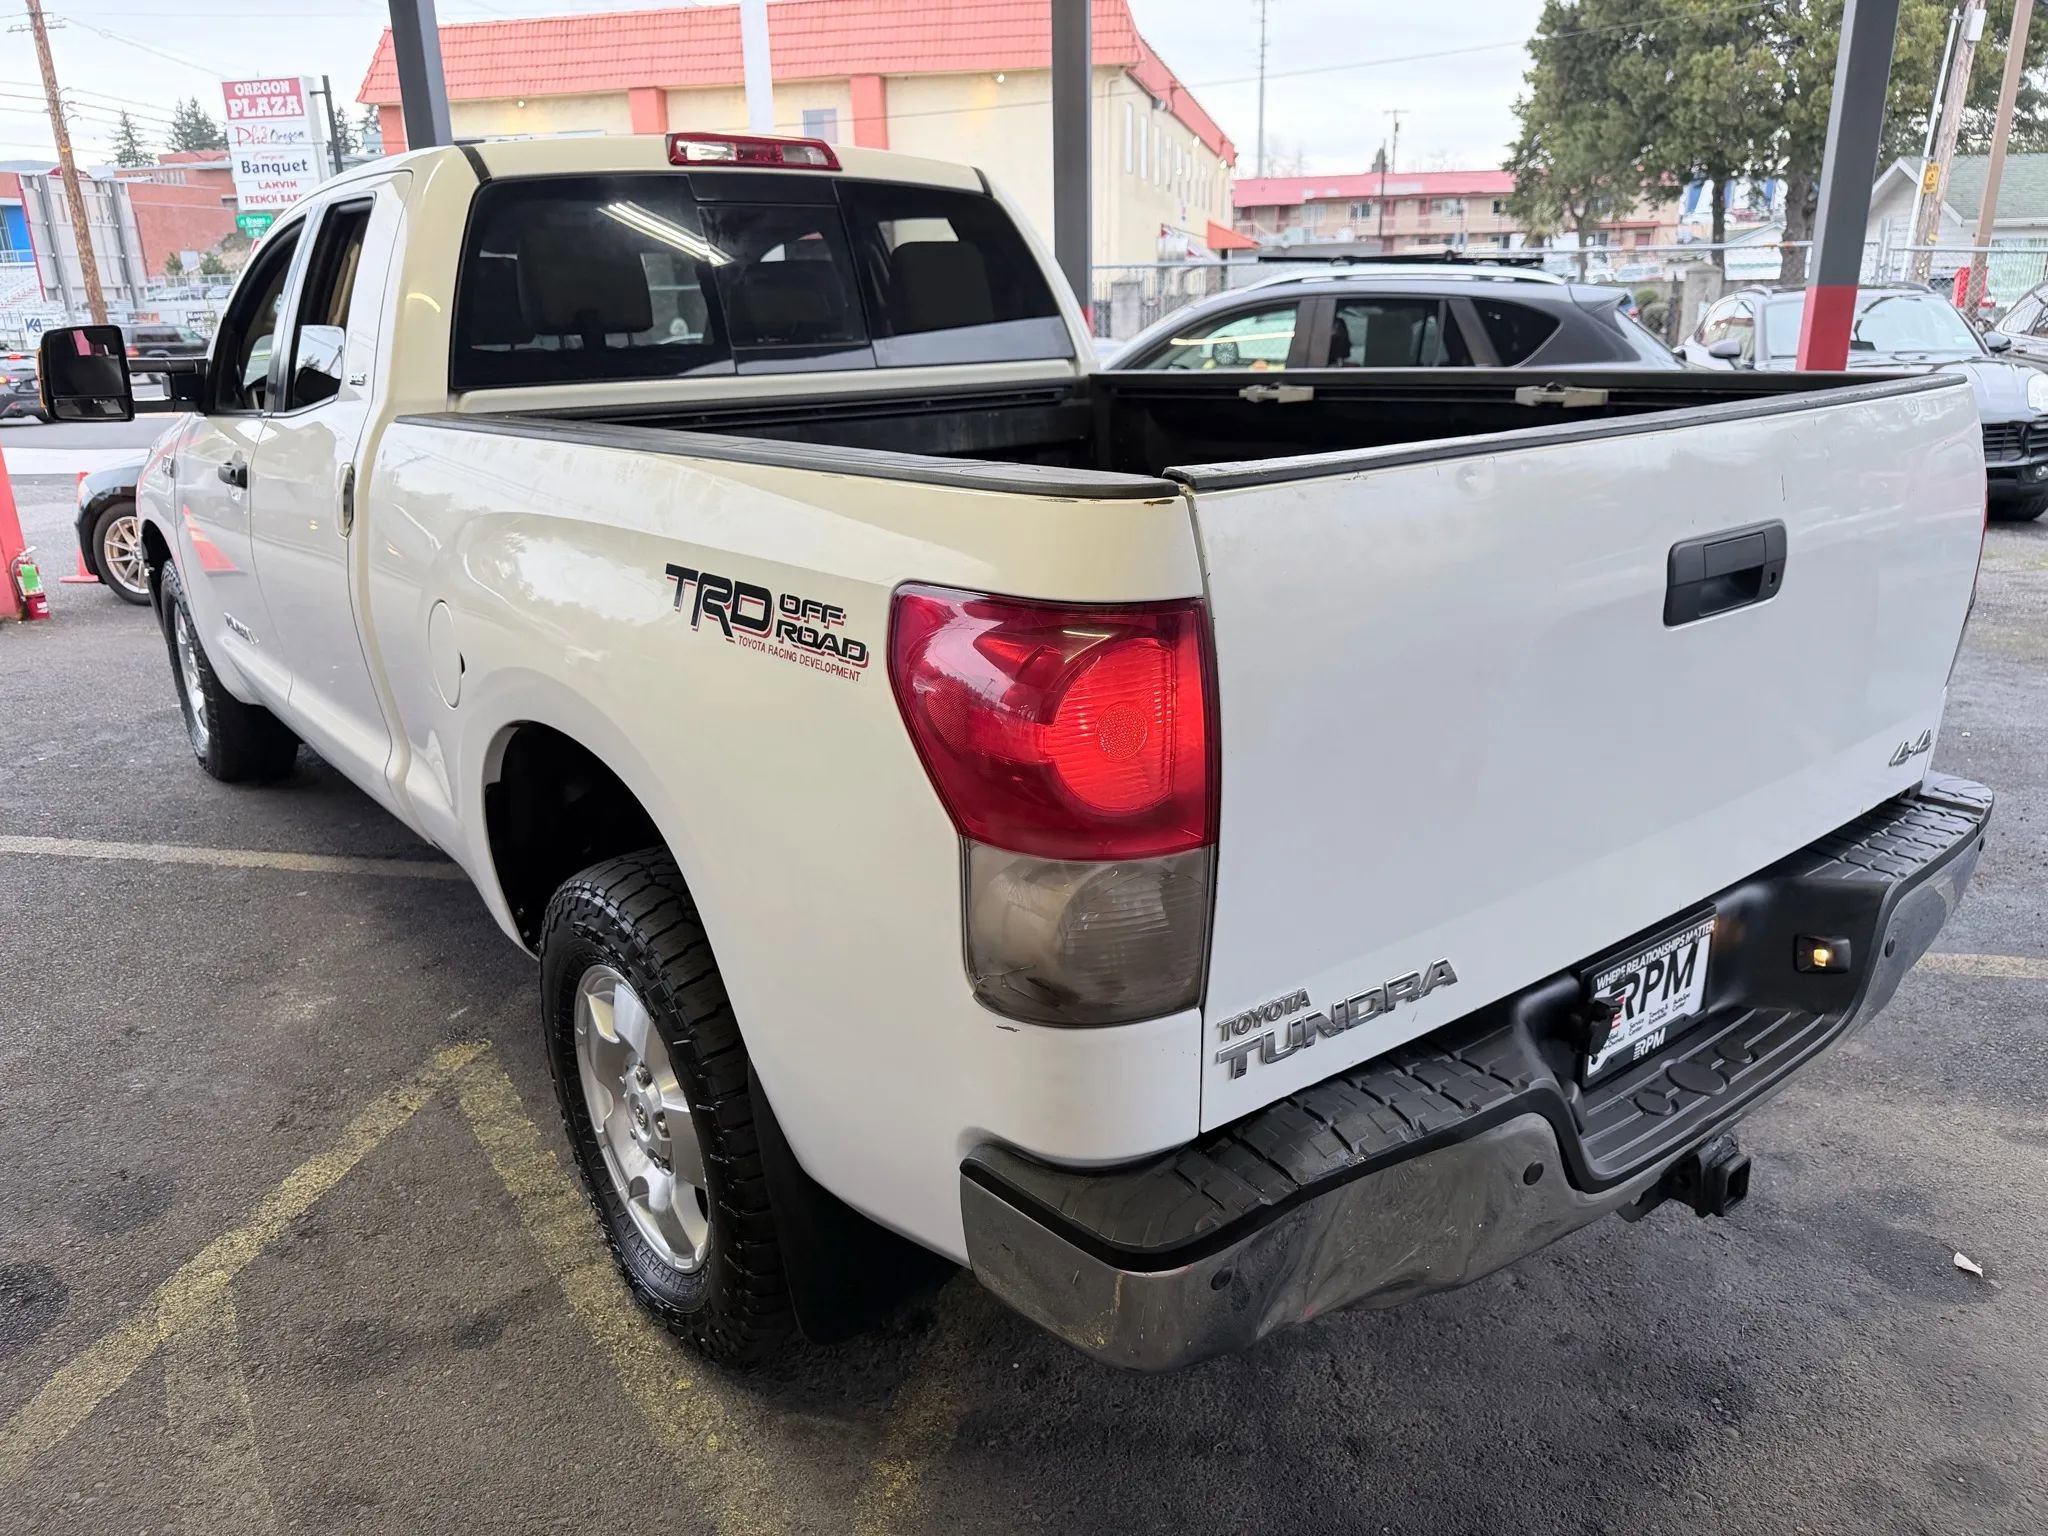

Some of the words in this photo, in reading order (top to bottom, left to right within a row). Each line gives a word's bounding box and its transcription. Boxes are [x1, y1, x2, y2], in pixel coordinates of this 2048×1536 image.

[228, 96, 302, 118] PLAZA
[234, 81, 290, 96] OREGON
[270, 129, 304, 144] Oregon
[241, 158, 308, 176] Banquet
[245, 194, 278, 204] FRENCH
[665, 563, 774, 638] TRD
[779, 593, 846, 628] OFF
[738, 635, 766, 652] TOYOTA
[768, 644, 797, 663] RACING
[799, 654, 861, 682] DEVELOPMENT
[776, 619, 869, 668] ROAD
[1596, 965, 1625, 991] WHERE
[1626, 935, 1685, 976] RELATIONSHIPS
[1685, 920, 1715, 945] MATTER
[1609, 941, 1699, 1021] RPM
[1215, 957, 1458, 1080] TUNDRA
[1217, 988, 1311, 1041] TOYOTA
[1633, 1026, 1667, 1060] RPM
